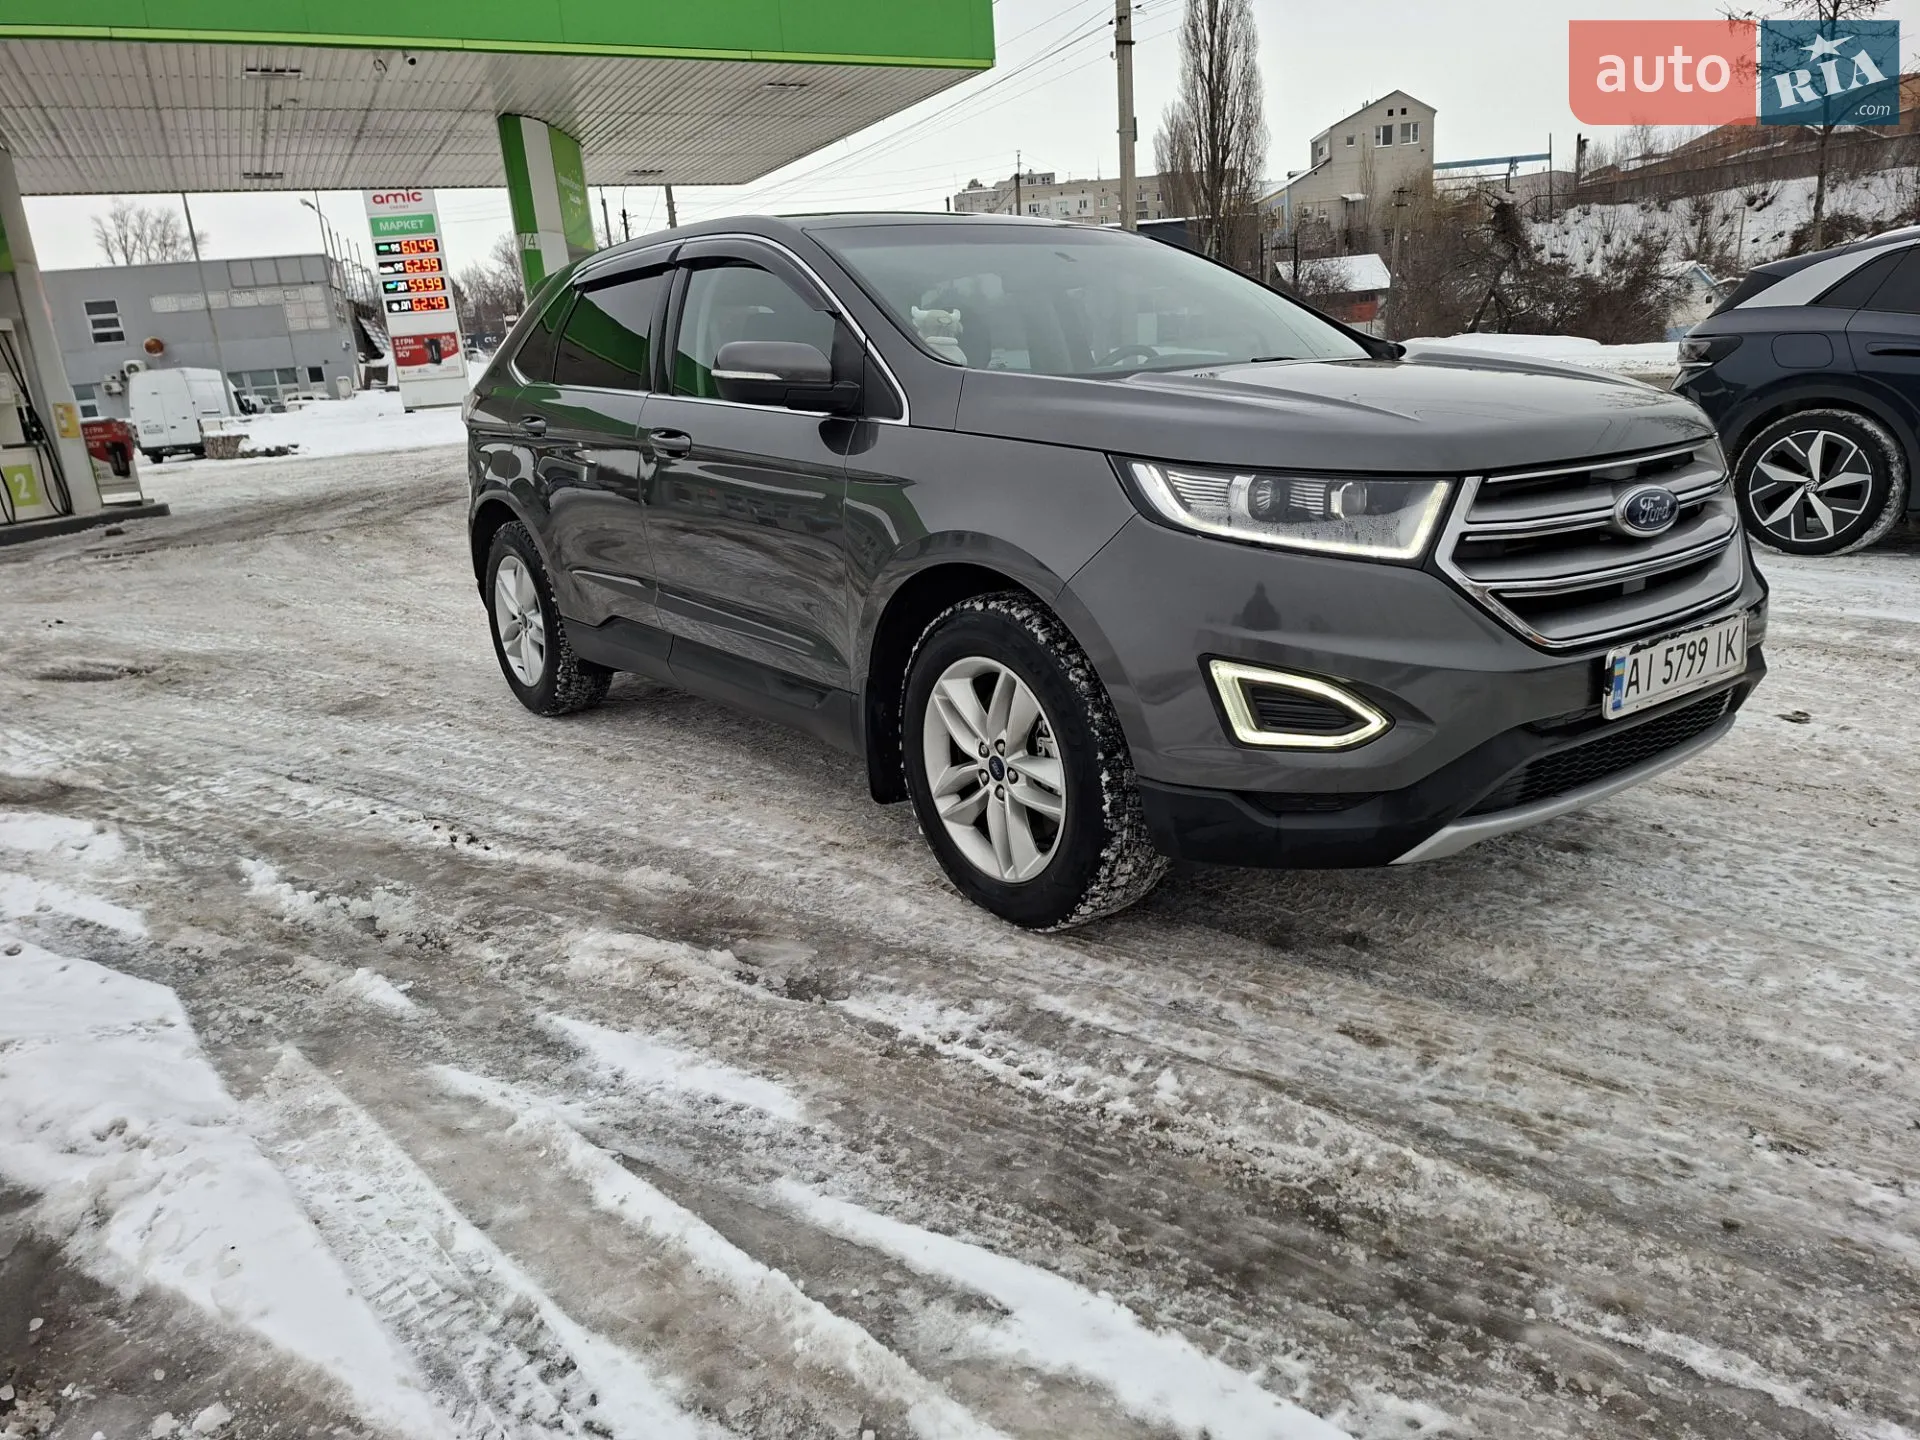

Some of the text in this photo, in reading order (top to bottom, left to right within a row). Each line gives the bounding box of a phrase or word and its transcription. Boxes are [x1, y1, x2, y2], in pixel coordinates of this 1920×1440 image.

[372, 191, 423, 205] amic
[379, 219, 425, 232] МАРКЕТ
[401, 239, 436, 254] 60.49
[404, 258, 439, 273] 62.99
[408, 277, 443, 292] 59.99
[412, 296, 446, 311] 62.49
[14, 473, 31, 499] 2
[1639, 495, 1672, 524] Ford
[1624, 625, 1739, 699] AI 5799 IK
